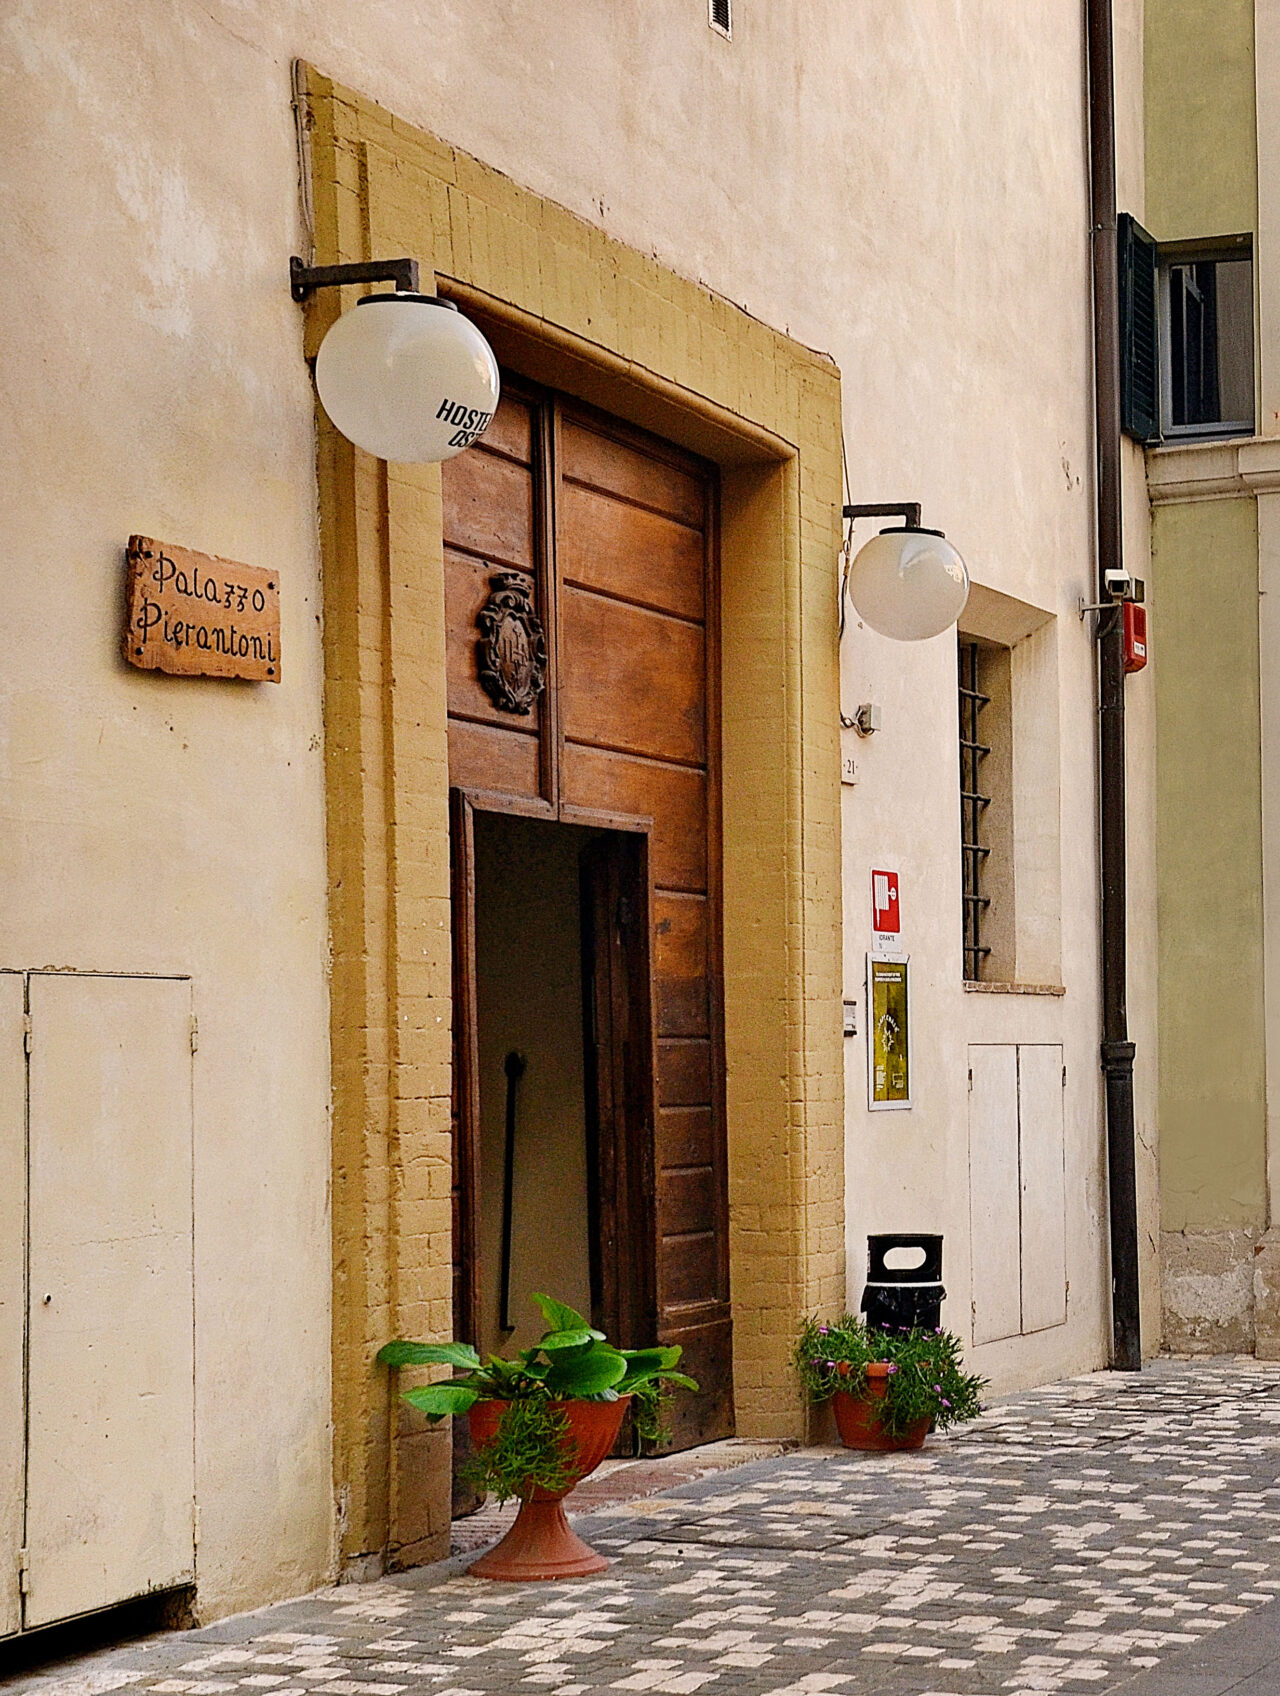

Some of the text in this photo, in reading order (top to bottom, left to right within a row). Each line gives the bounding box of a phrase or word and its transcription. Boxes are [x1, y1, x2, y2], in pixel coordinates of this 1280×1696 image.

[152, 550, 265, 613] Palazzo
[136, 597, 276, 662] Pierantoni
[847, 759, 855, 774] 21
